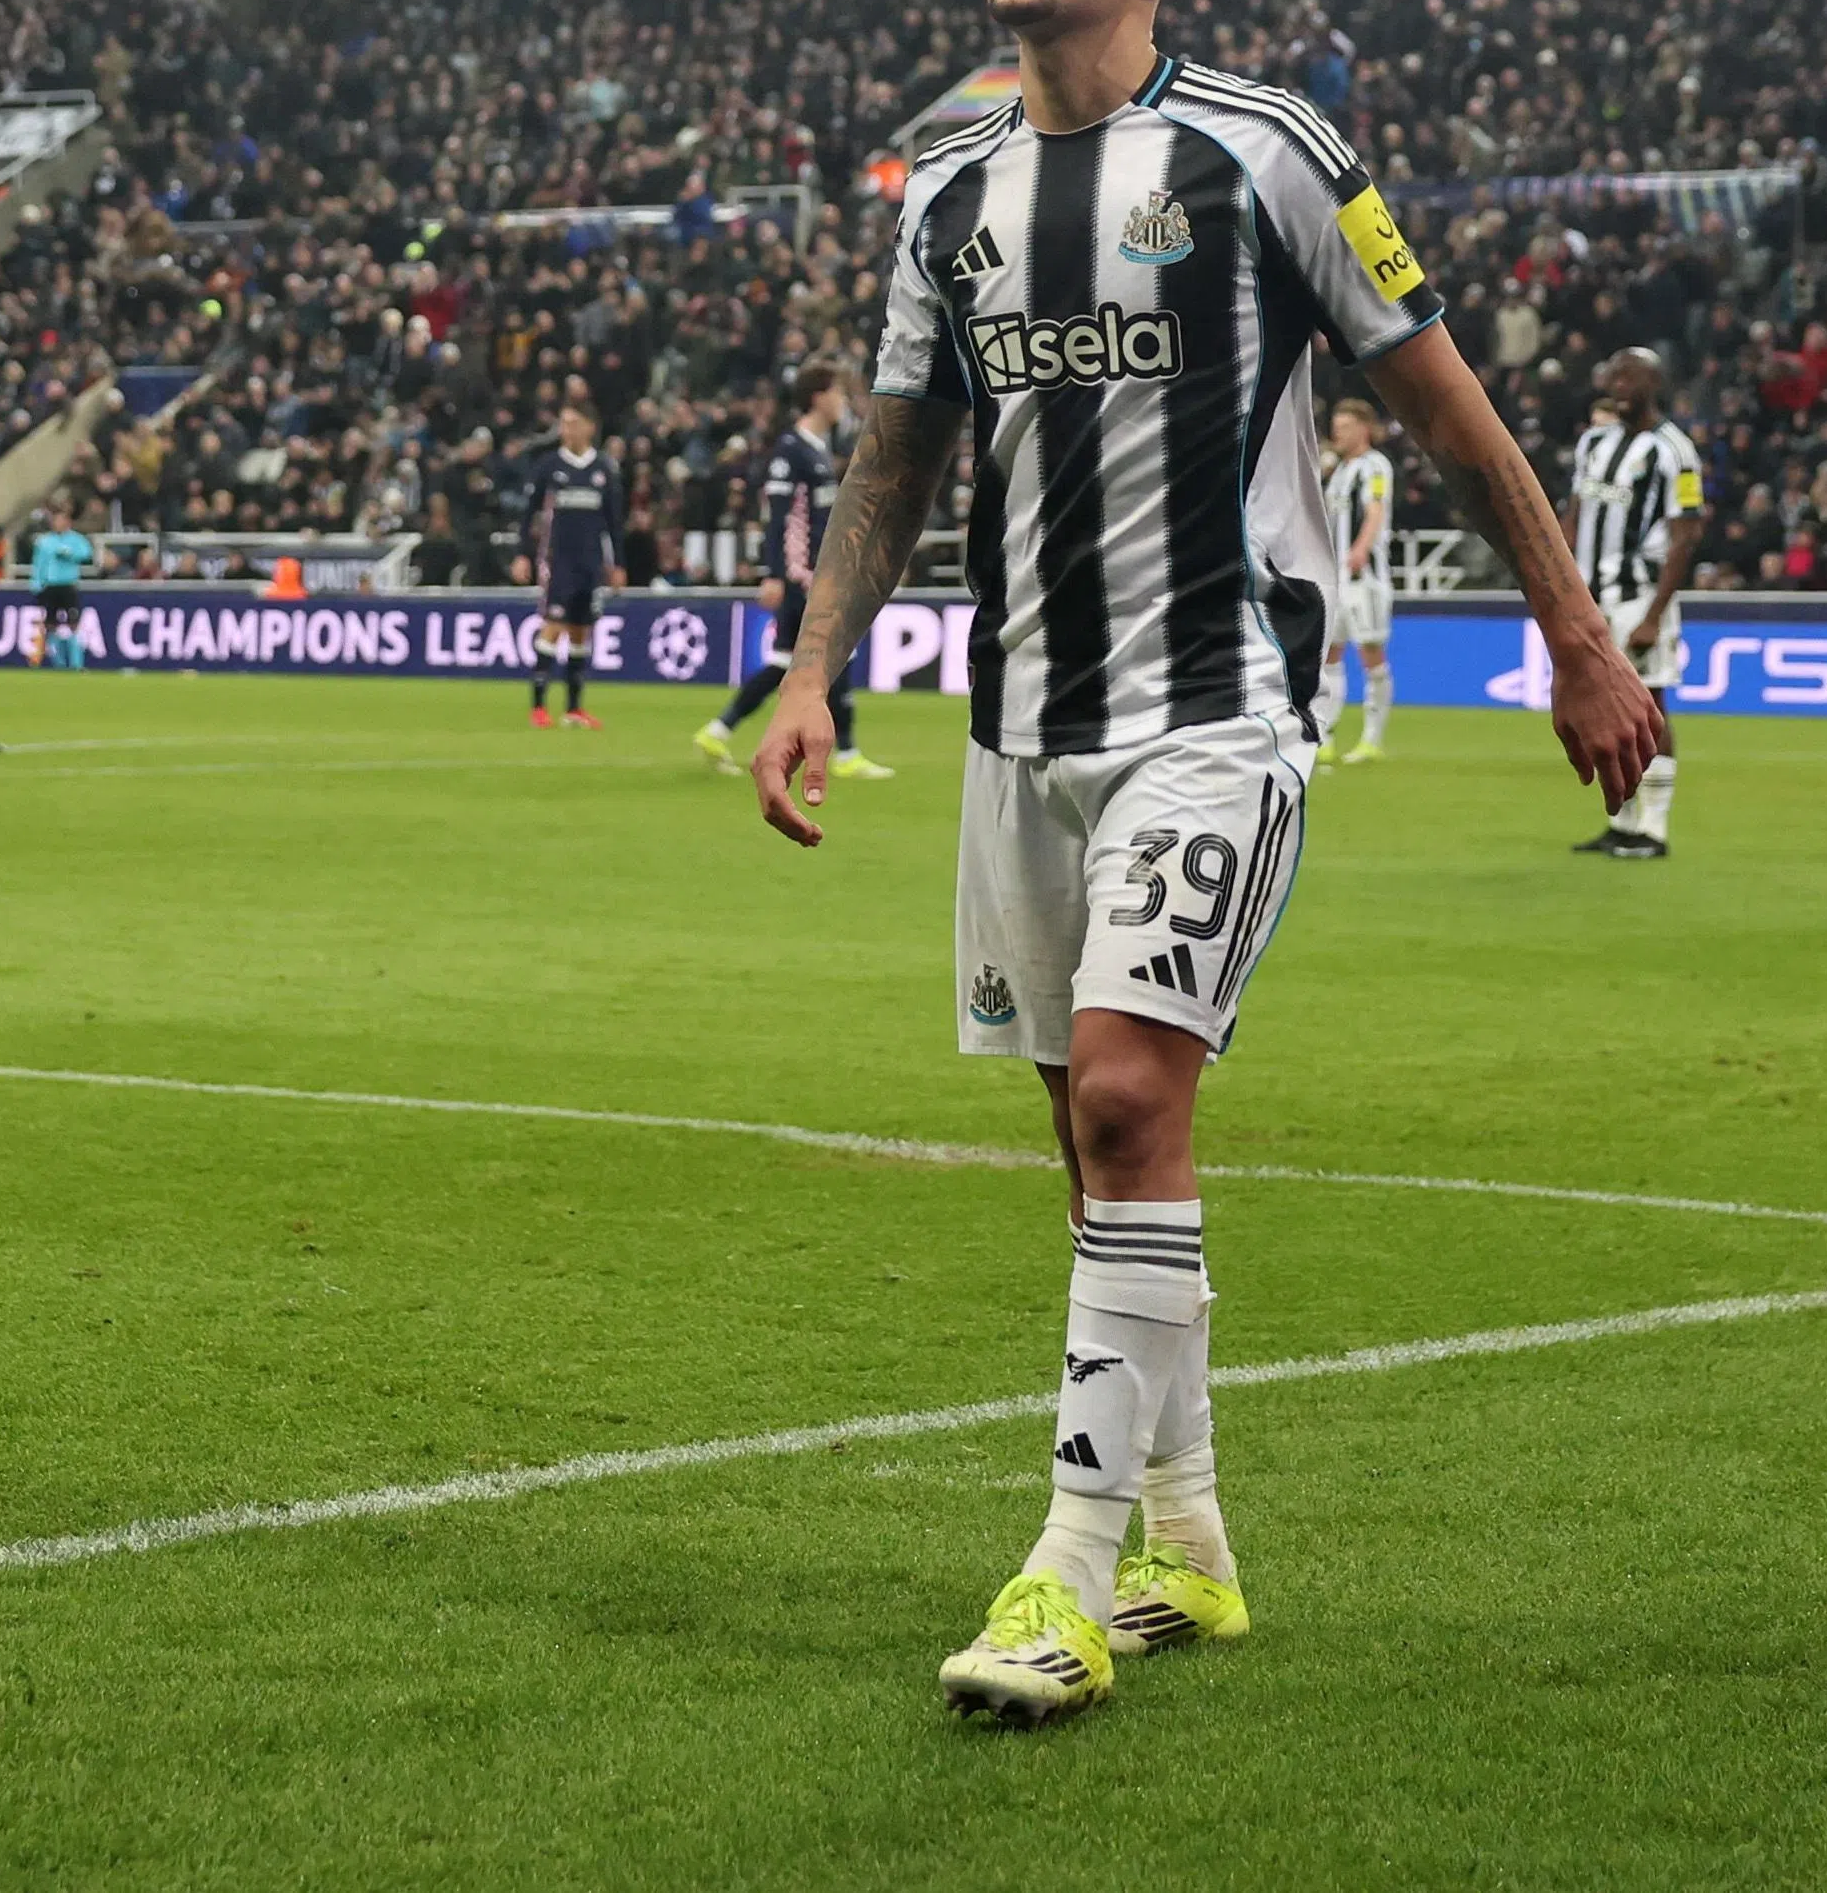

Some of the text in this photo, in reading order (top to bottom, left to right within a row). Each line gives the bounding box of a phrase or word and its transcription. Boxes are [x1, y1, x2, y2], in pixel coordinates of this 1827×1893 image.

[1029, 309, 1173, 381] sela
[116, 606, 411, 666] CHAMPIONS
[425, 611, 624, 671] LEAE
[1108, 828, 1239, 940] 39
